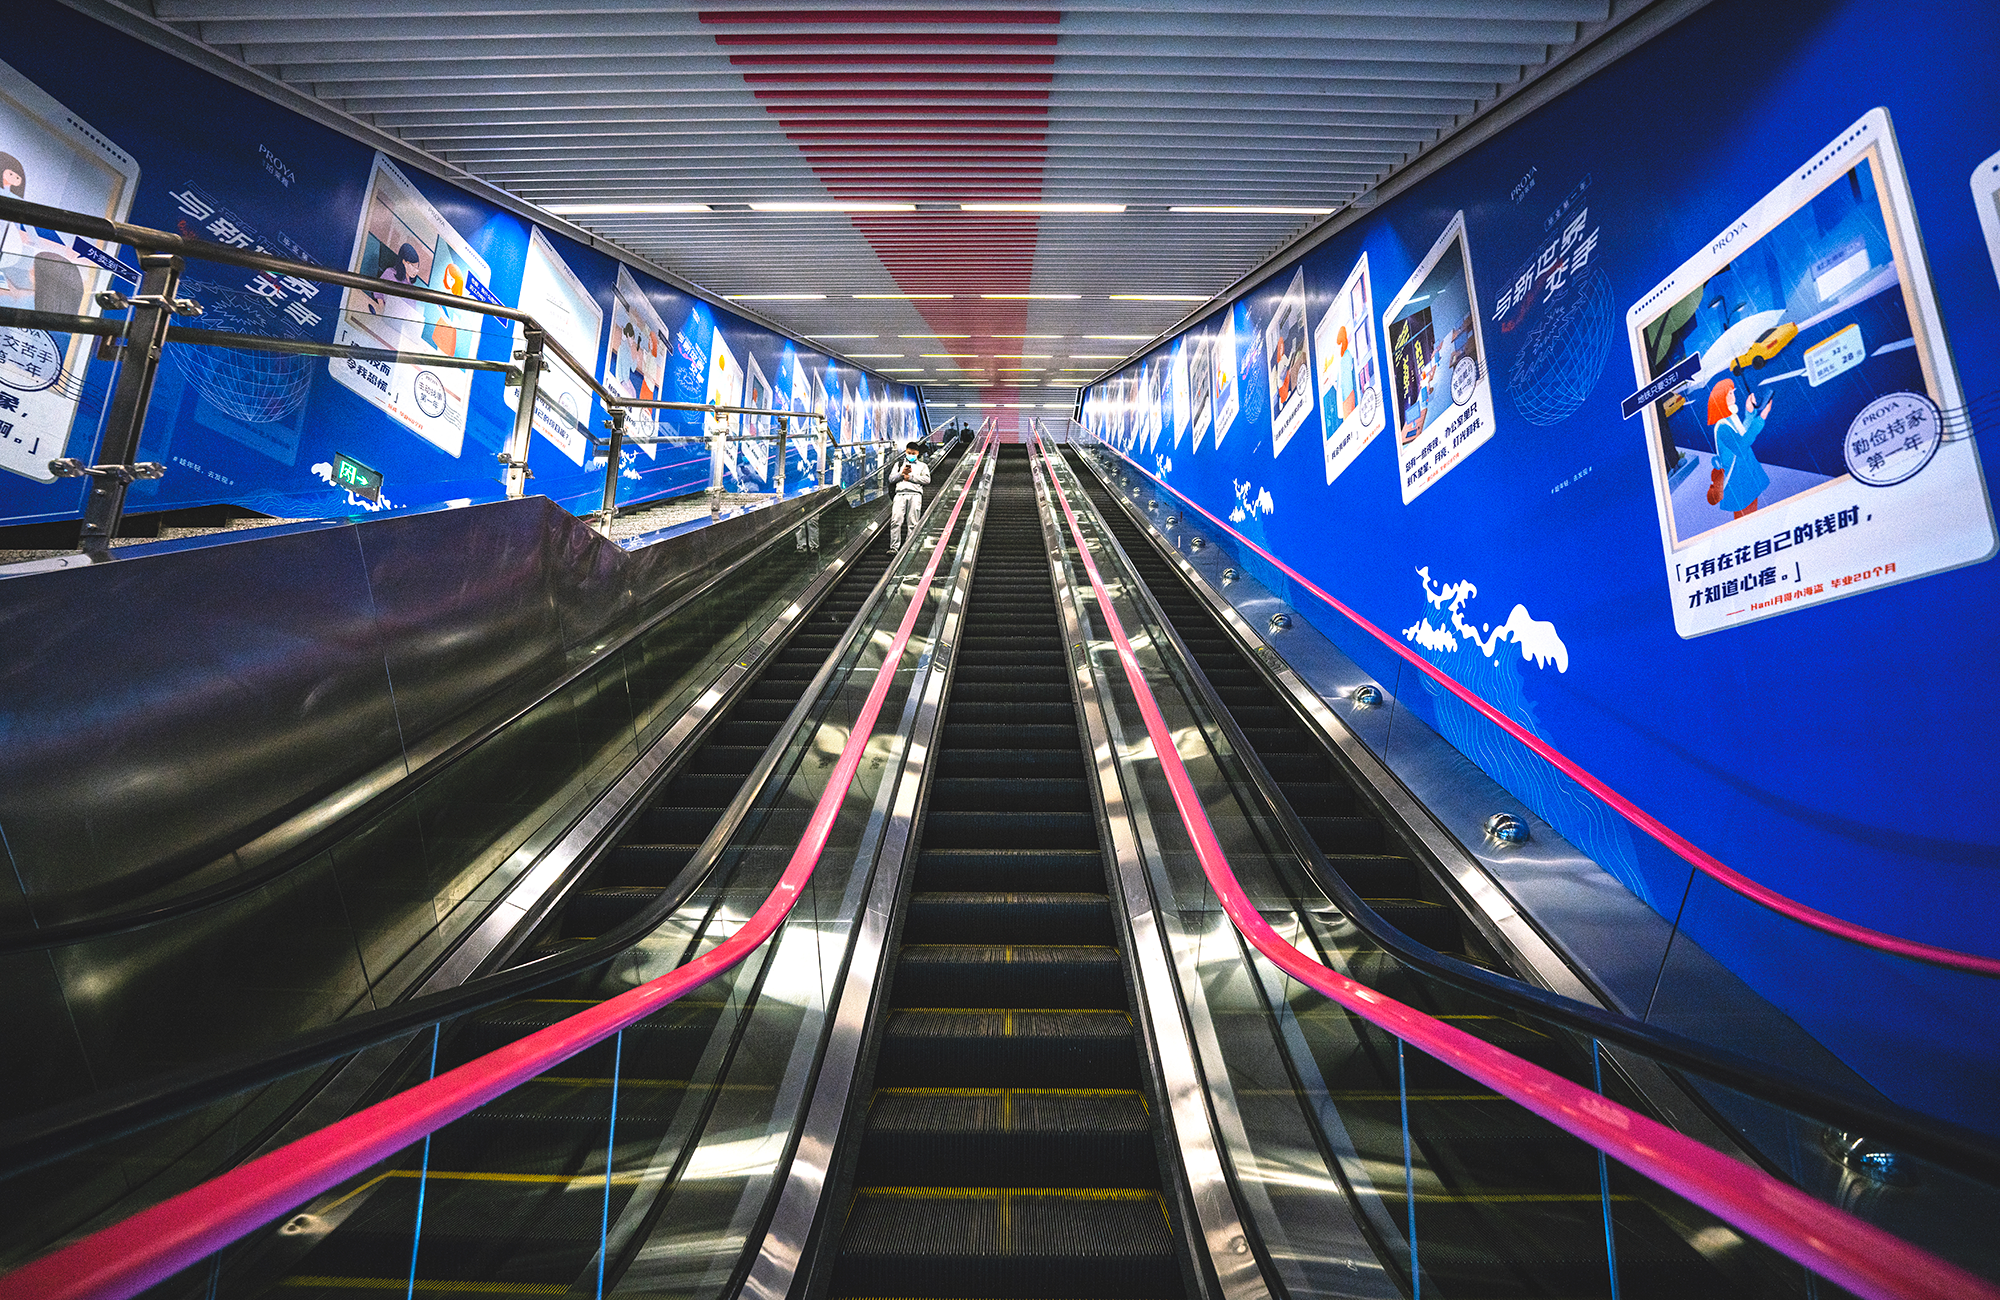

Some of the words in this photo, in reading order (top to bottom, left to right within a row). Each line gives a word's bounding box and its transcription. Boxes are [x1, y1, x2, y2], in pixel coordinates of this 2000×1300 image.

[258, 143, 296, 184] PROYA
[1510, 166, 1538, 201] PROYA
[1712, 222, 1748, 255] PROYA
[1491, 206, 1588, 322] 与新世界
[1543, 226, 1600, 304] 交手
[0, 334, 53, 364] 交苦手
[1842, 351, 1855, 365] 28
[1851, 407, 1928, 458] 勤俭持家
[1862, 401, 1900, 426] PROYA
[1866, 433, 1925, 473] 第一年
[1675, 504, 1873, 584] 「只有在花自己的钱时，
[1688, 561, 1802, 609] 才知道心疼。」
[1830, 562, 1897, 589] 毕业20个月
